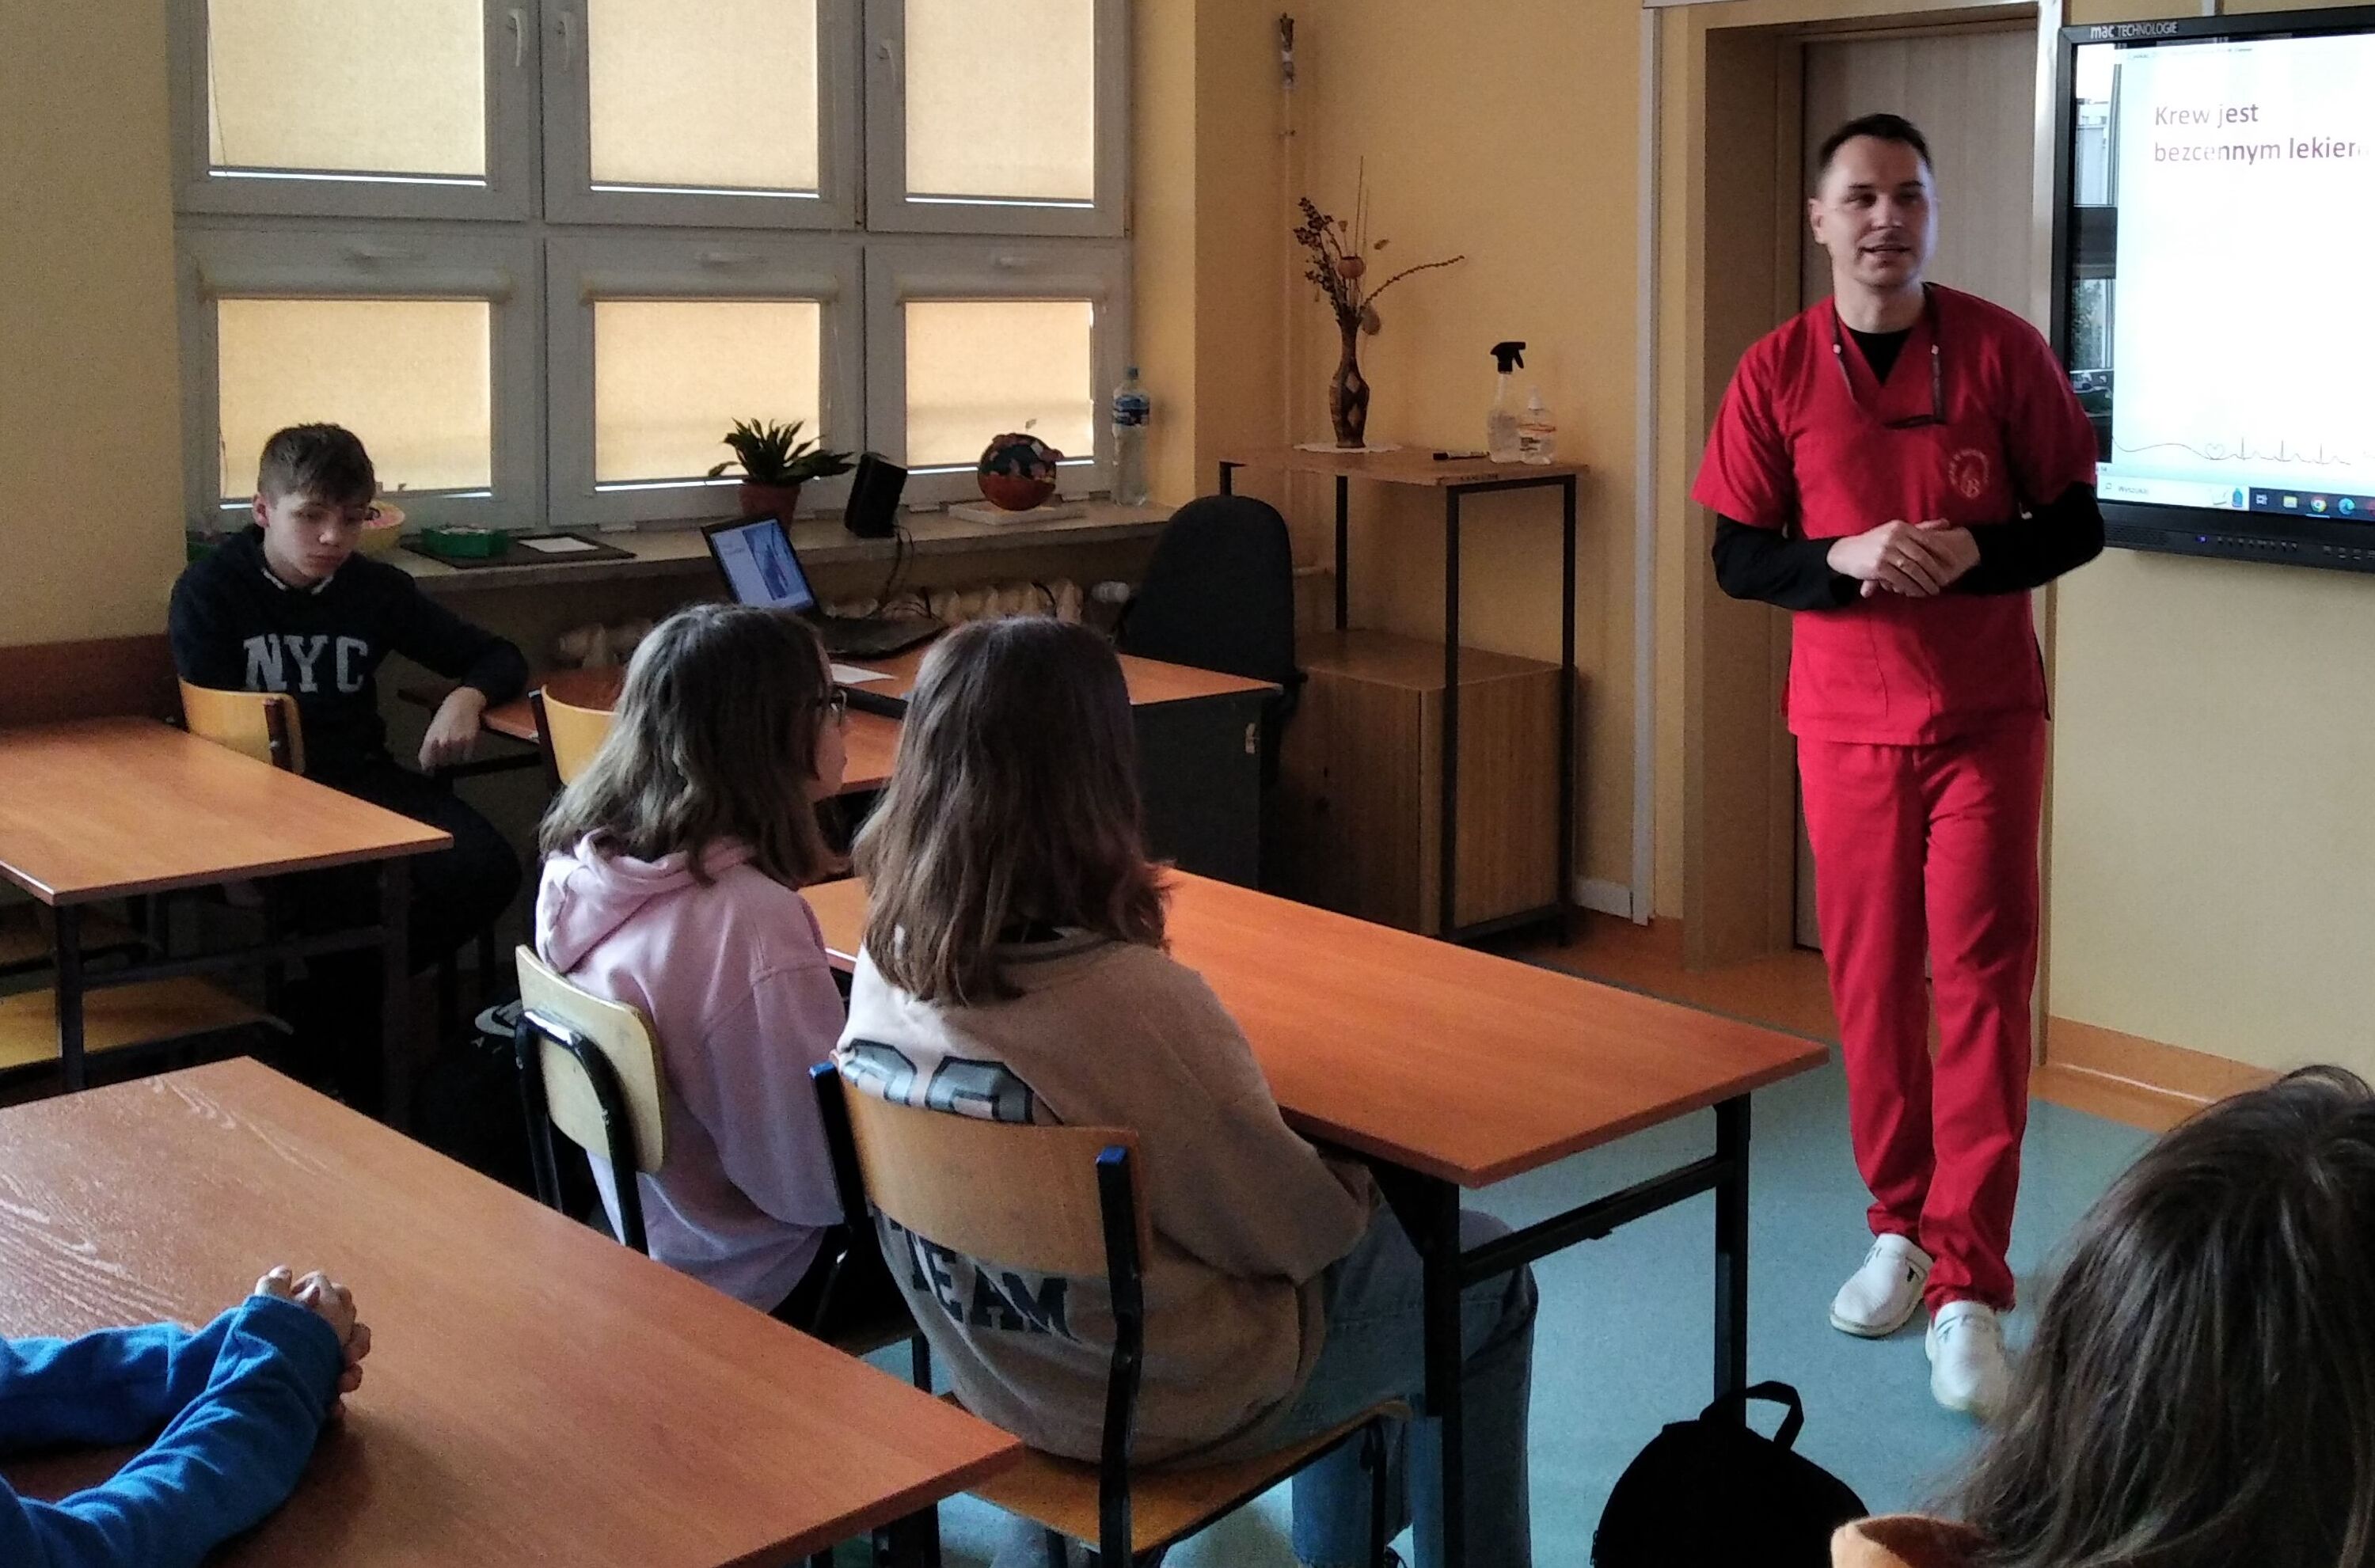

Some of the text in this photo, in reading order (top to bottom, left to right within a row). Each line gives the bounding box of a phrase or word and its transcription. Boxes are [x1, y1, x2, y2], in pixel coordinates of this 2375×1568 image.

[2090, 21, 2178, 39] mac TECHNOLOGIE
[2155, 104, 2259, 129] Krew jest
[2154, 142, 2281, 165] bezcennym
[243, 633, 368, 693] NYC
